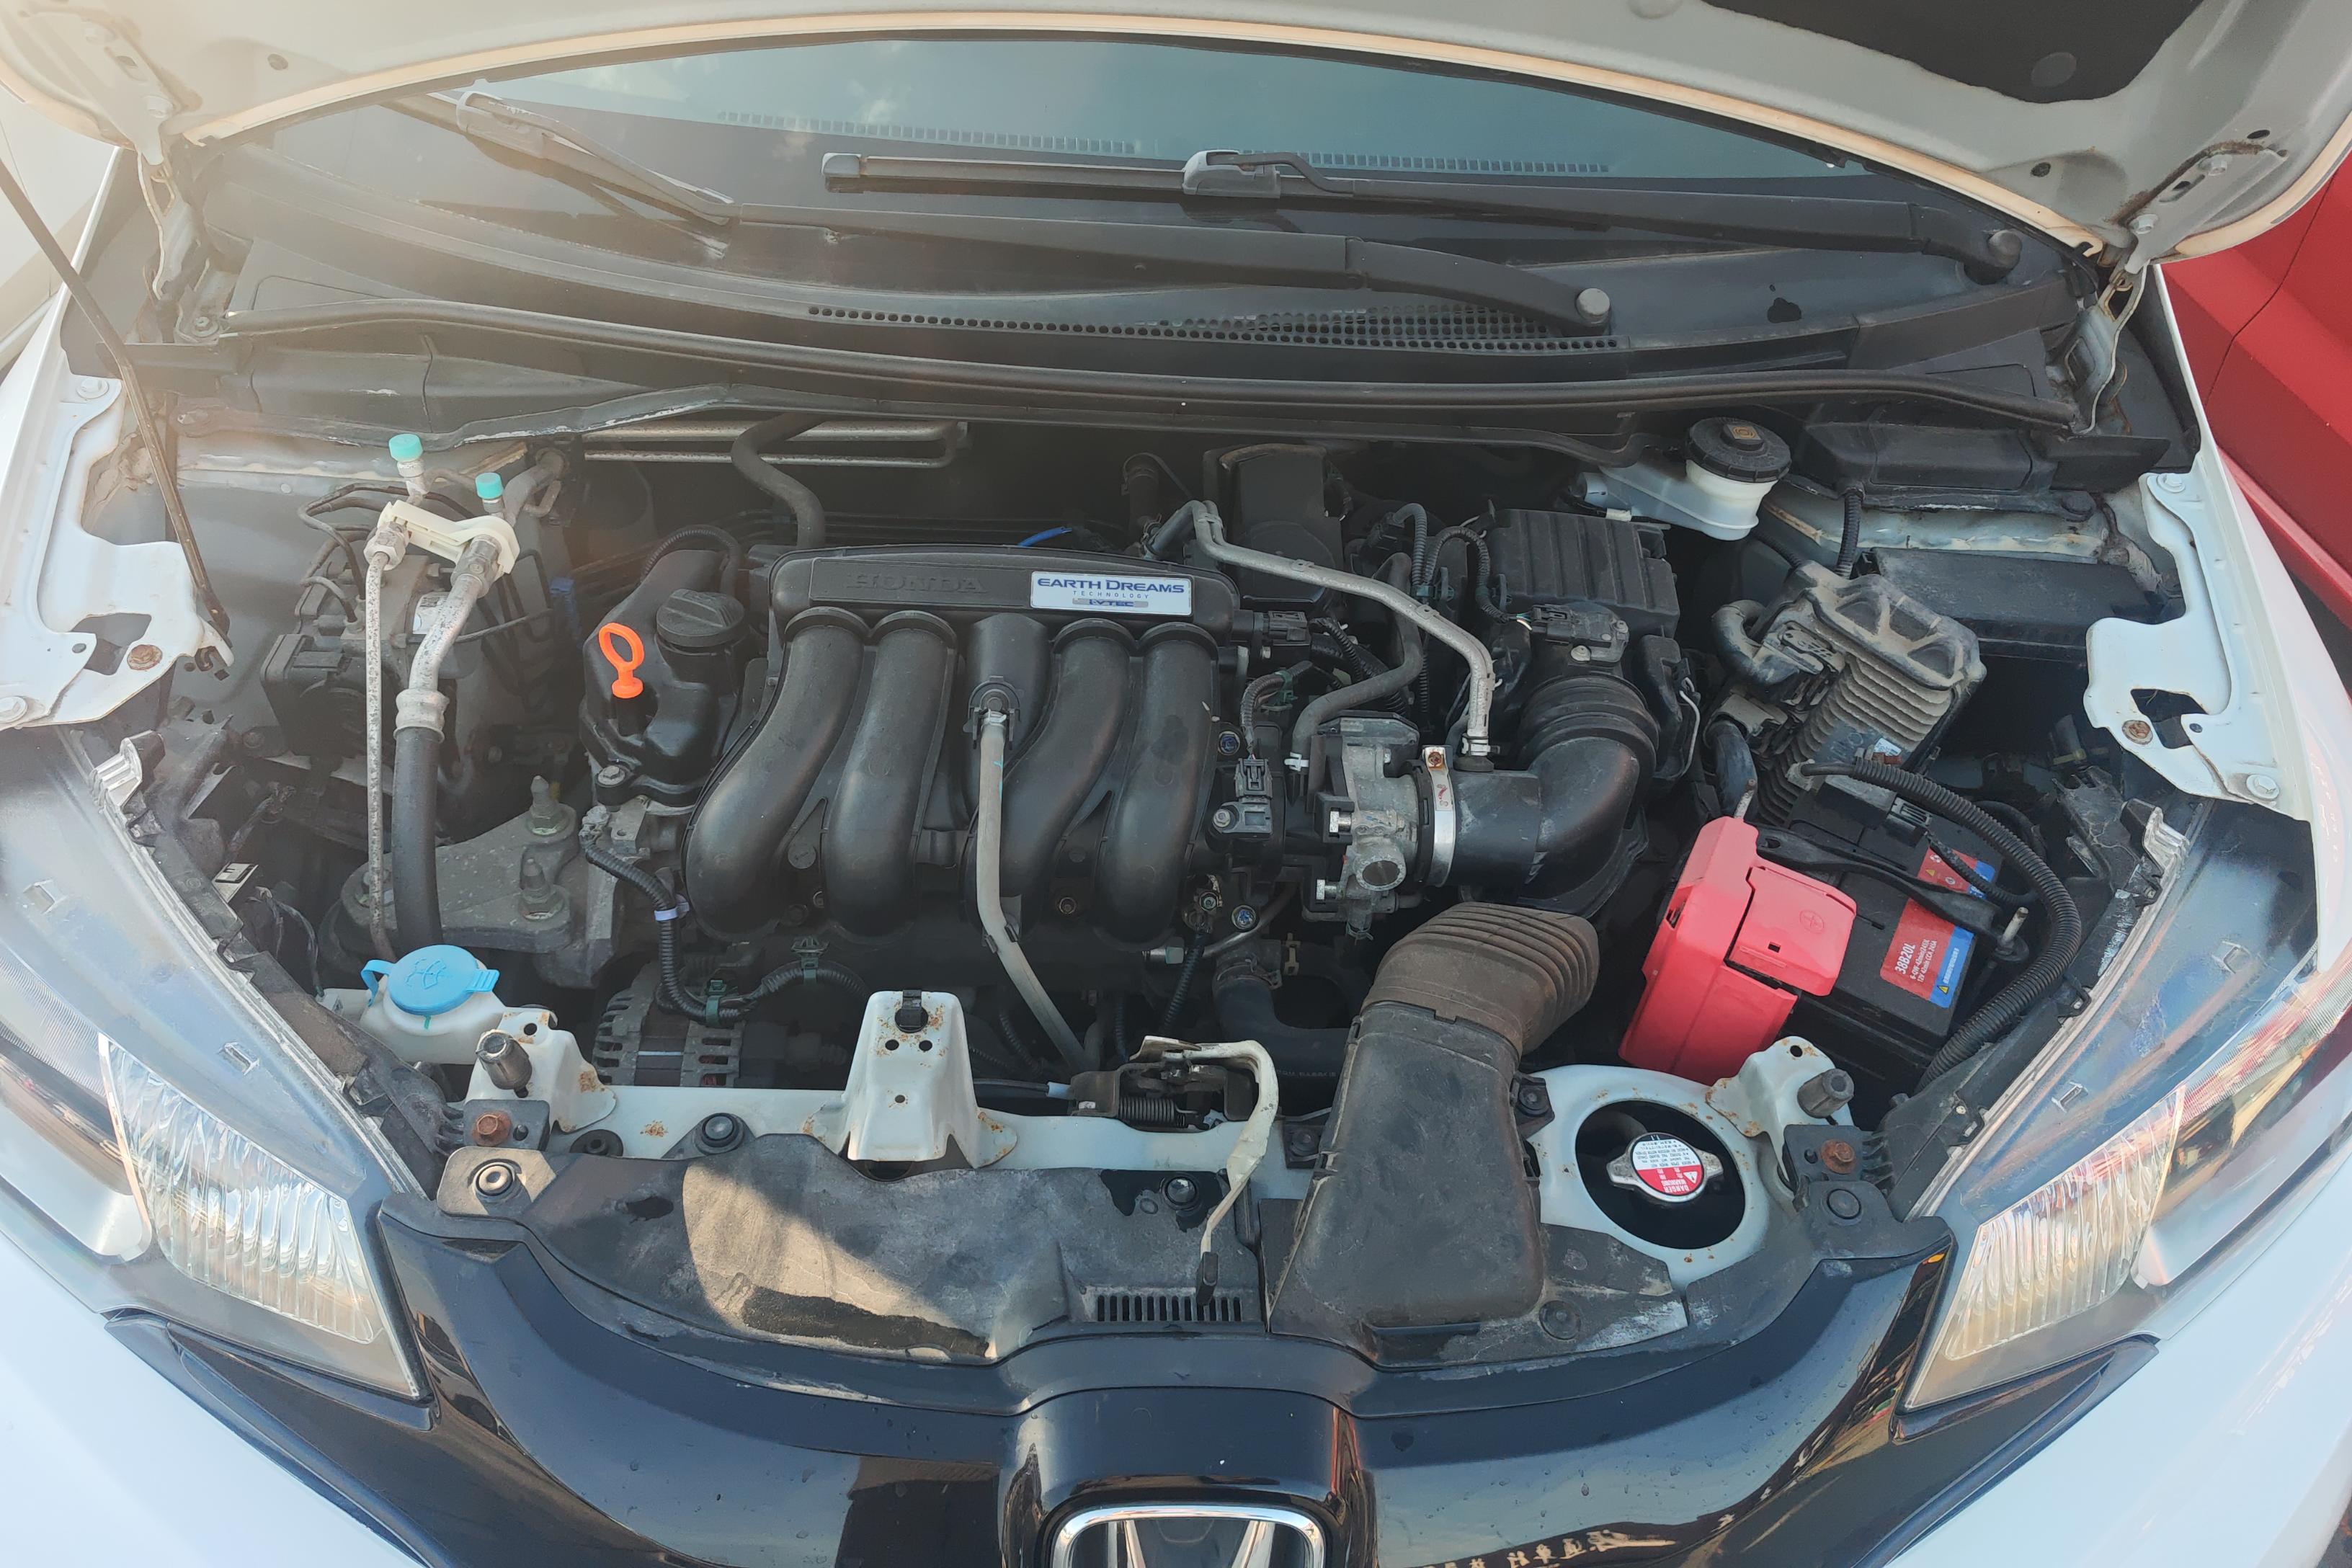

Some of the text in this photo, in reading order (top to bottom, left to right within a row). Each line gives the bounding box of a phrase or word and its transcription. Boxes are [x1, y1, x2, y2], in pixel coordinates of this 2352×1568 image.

[845, 574, 989, 594] HONDA
[1038, 578, 1185, 593] EARTH DREAMS
[1073, 590, 1149, 599] TECHNOLOGY
[1894, 943, 1916, 974] 38B20L
